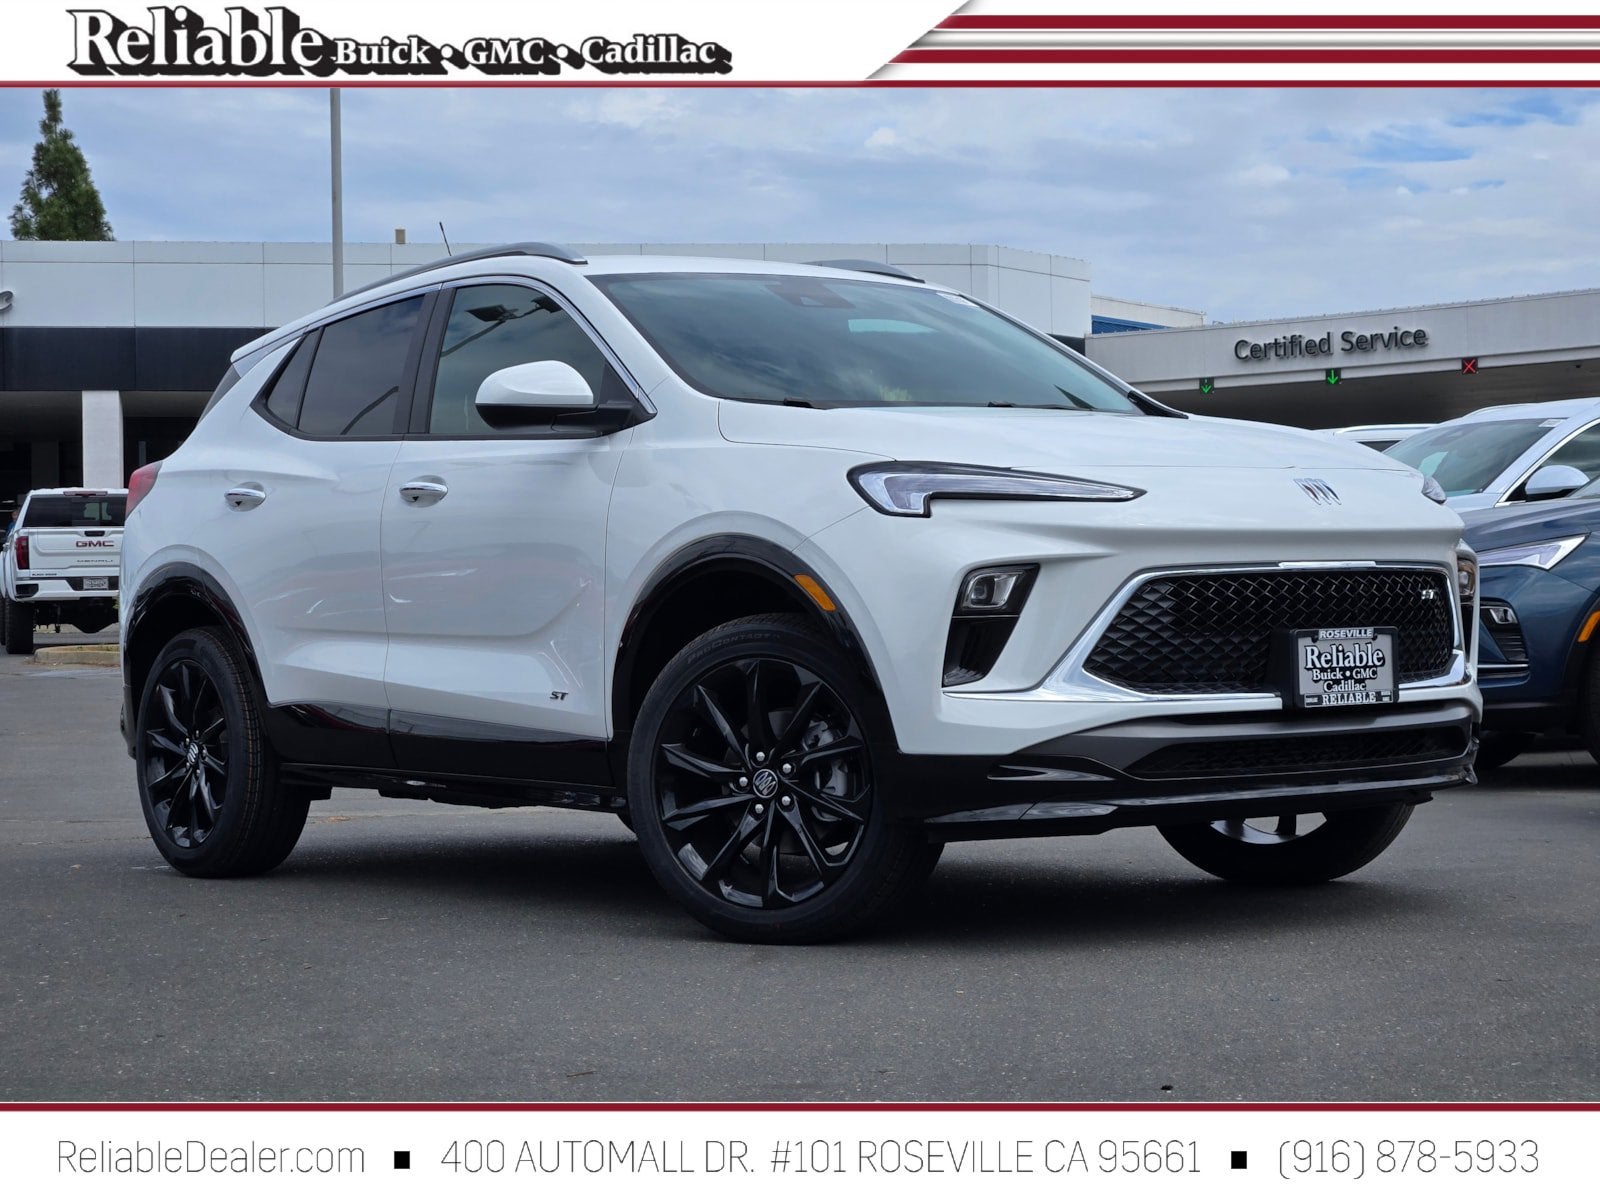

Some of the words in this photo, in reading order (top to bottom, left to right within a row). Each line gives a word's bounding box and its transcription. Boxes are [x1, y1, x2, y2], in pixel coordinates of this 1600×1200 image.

[1234, 332, 1331, 361] Certified
[1340, 326, 1428, 352] Service
[75, 540, 115, 548] GMC
[1319, 629, 1374, 639] ROSEVILLE
[1304, 642, 1385, 670] Reliable
[1312, 668, 1344, 682] Buick
[1352, 667, 1378, 680] GMC
[1323, 680, 1367, 693] Cadillac
[549, 690, 569, 701] ST
[1321, 692, 1377, 706] RELIABLE
